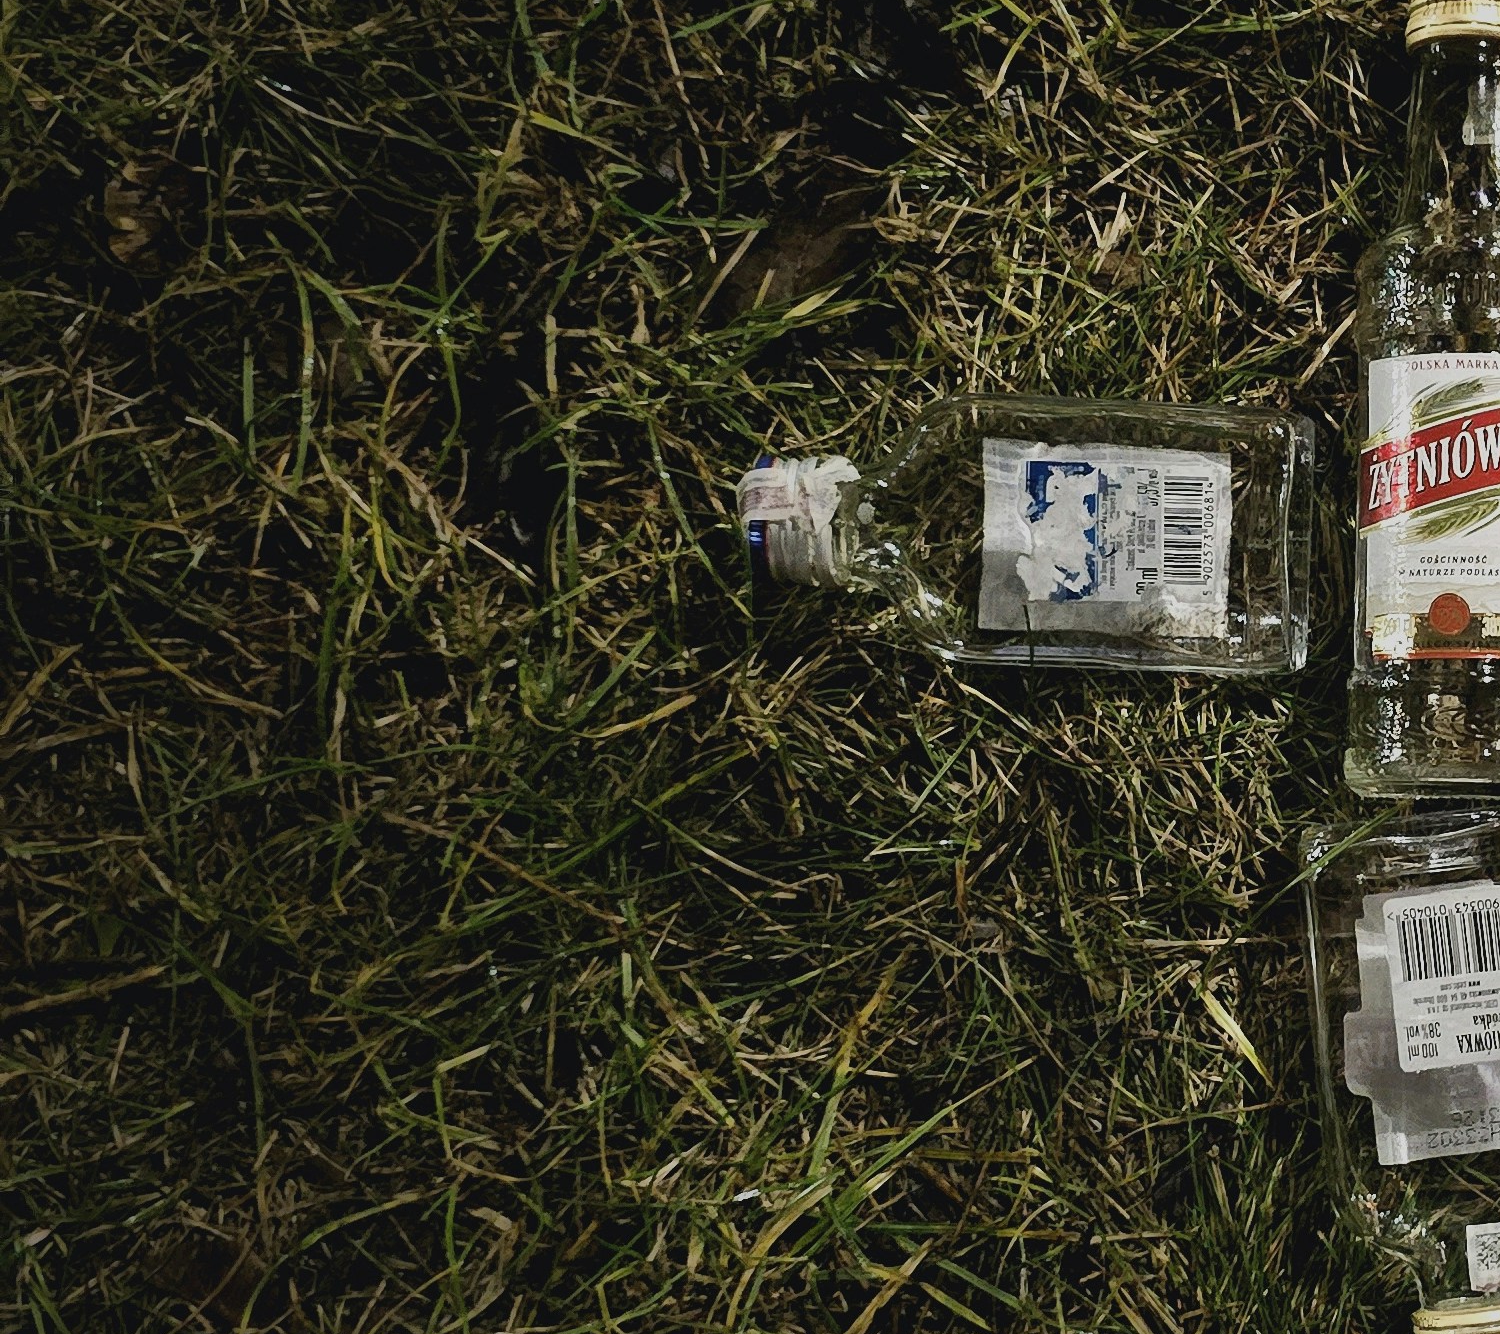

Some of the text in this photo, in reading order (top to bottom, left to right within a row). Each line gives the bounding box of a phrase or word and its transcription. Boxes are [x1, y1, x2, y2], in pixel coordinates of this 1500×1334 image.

[1455, 359, 1499, 370] MARKA
[1203, 482, 1215, 528] 006814
[1202, 533, 1214, 581] 902573
[1420, 554, 1488, 564] GOŚCINNOŚĆ
[1409, 568, 1456, 576] NATURZE
[1402, 904, 1447, 920] 010405
[1454, 898, 1500, 914] 900343
[1408, 1042, 1439, 1061] 100 ml
